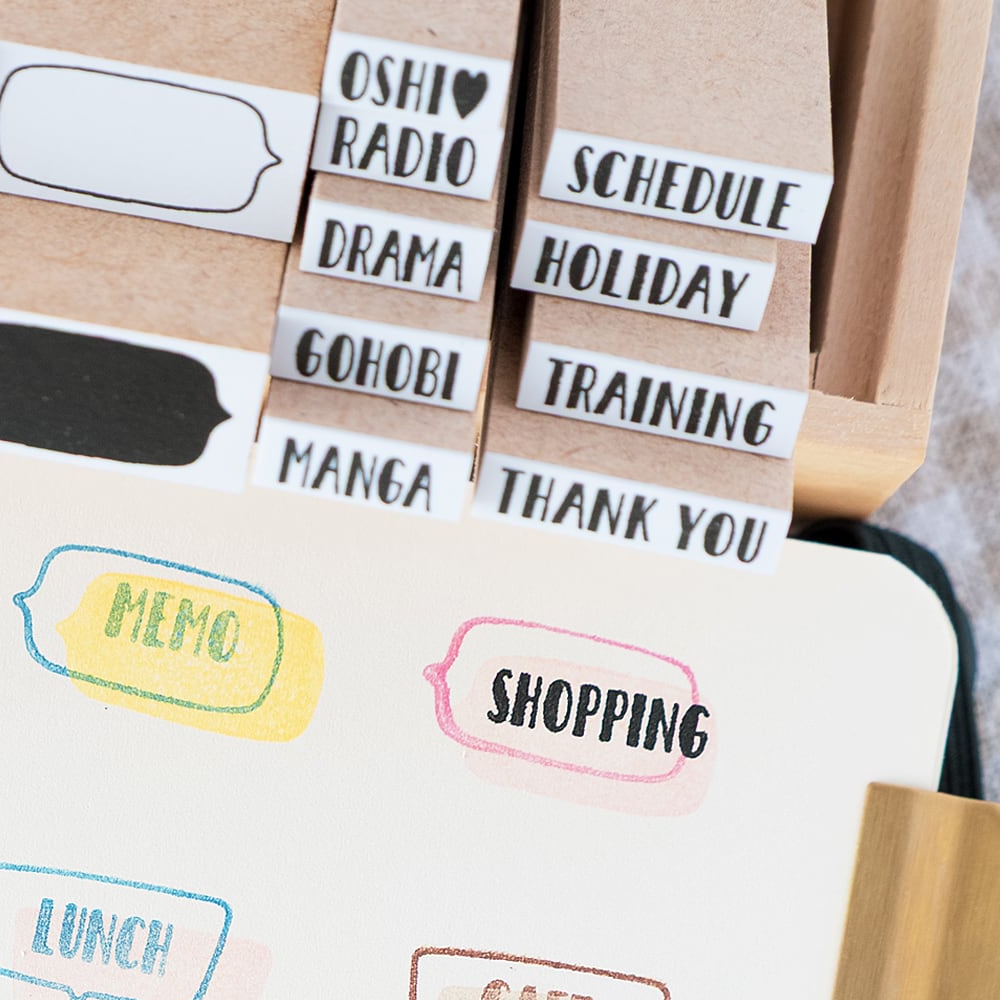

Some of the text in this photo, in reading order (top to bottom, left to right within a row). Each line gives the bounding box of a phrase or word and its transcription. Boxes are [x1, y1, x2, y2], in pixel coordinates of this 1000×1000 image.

[330, 116, 476, 188] RADIO
[566, 145, 801, 231] SCHEDULE
[318, 219, 464, 292] DRAMA
[534, 237, 749, 318] HOLIDAY
[296, 328, 460, 400] GOHOBI
[548, 358, 777, 447] TRAINING
[278, 437, 432, 512] MANGA
[500, 466, 768, 563] THANK YOU
[103, 582, 240, 663] MEMO
[487, 669, 711, 759] SHOPPING
[32, 897, 173, 977] LUNCH
